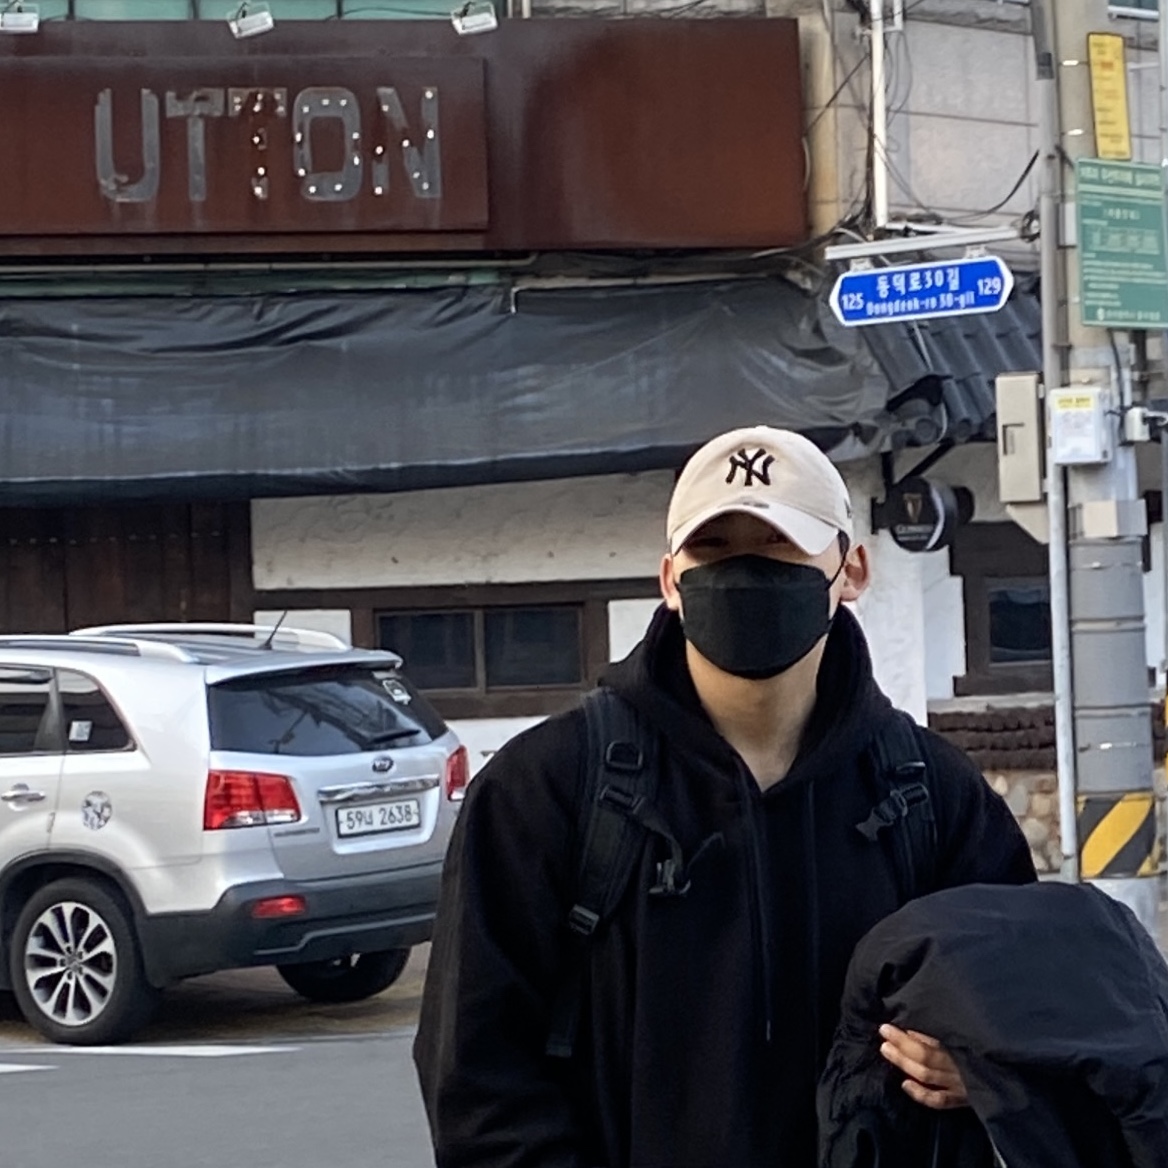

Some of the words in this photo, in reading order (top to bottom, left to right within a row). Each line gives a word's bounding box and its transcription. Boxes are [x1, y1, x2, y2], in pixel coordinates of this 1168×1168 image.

[94, 86, 442, 203] UTTON
[978, 277, 1001, 295] 129
[842, 292, 864, 310] 125
[725, 448, 775, 486] NY
[379, 805, 412, 825] 2638
